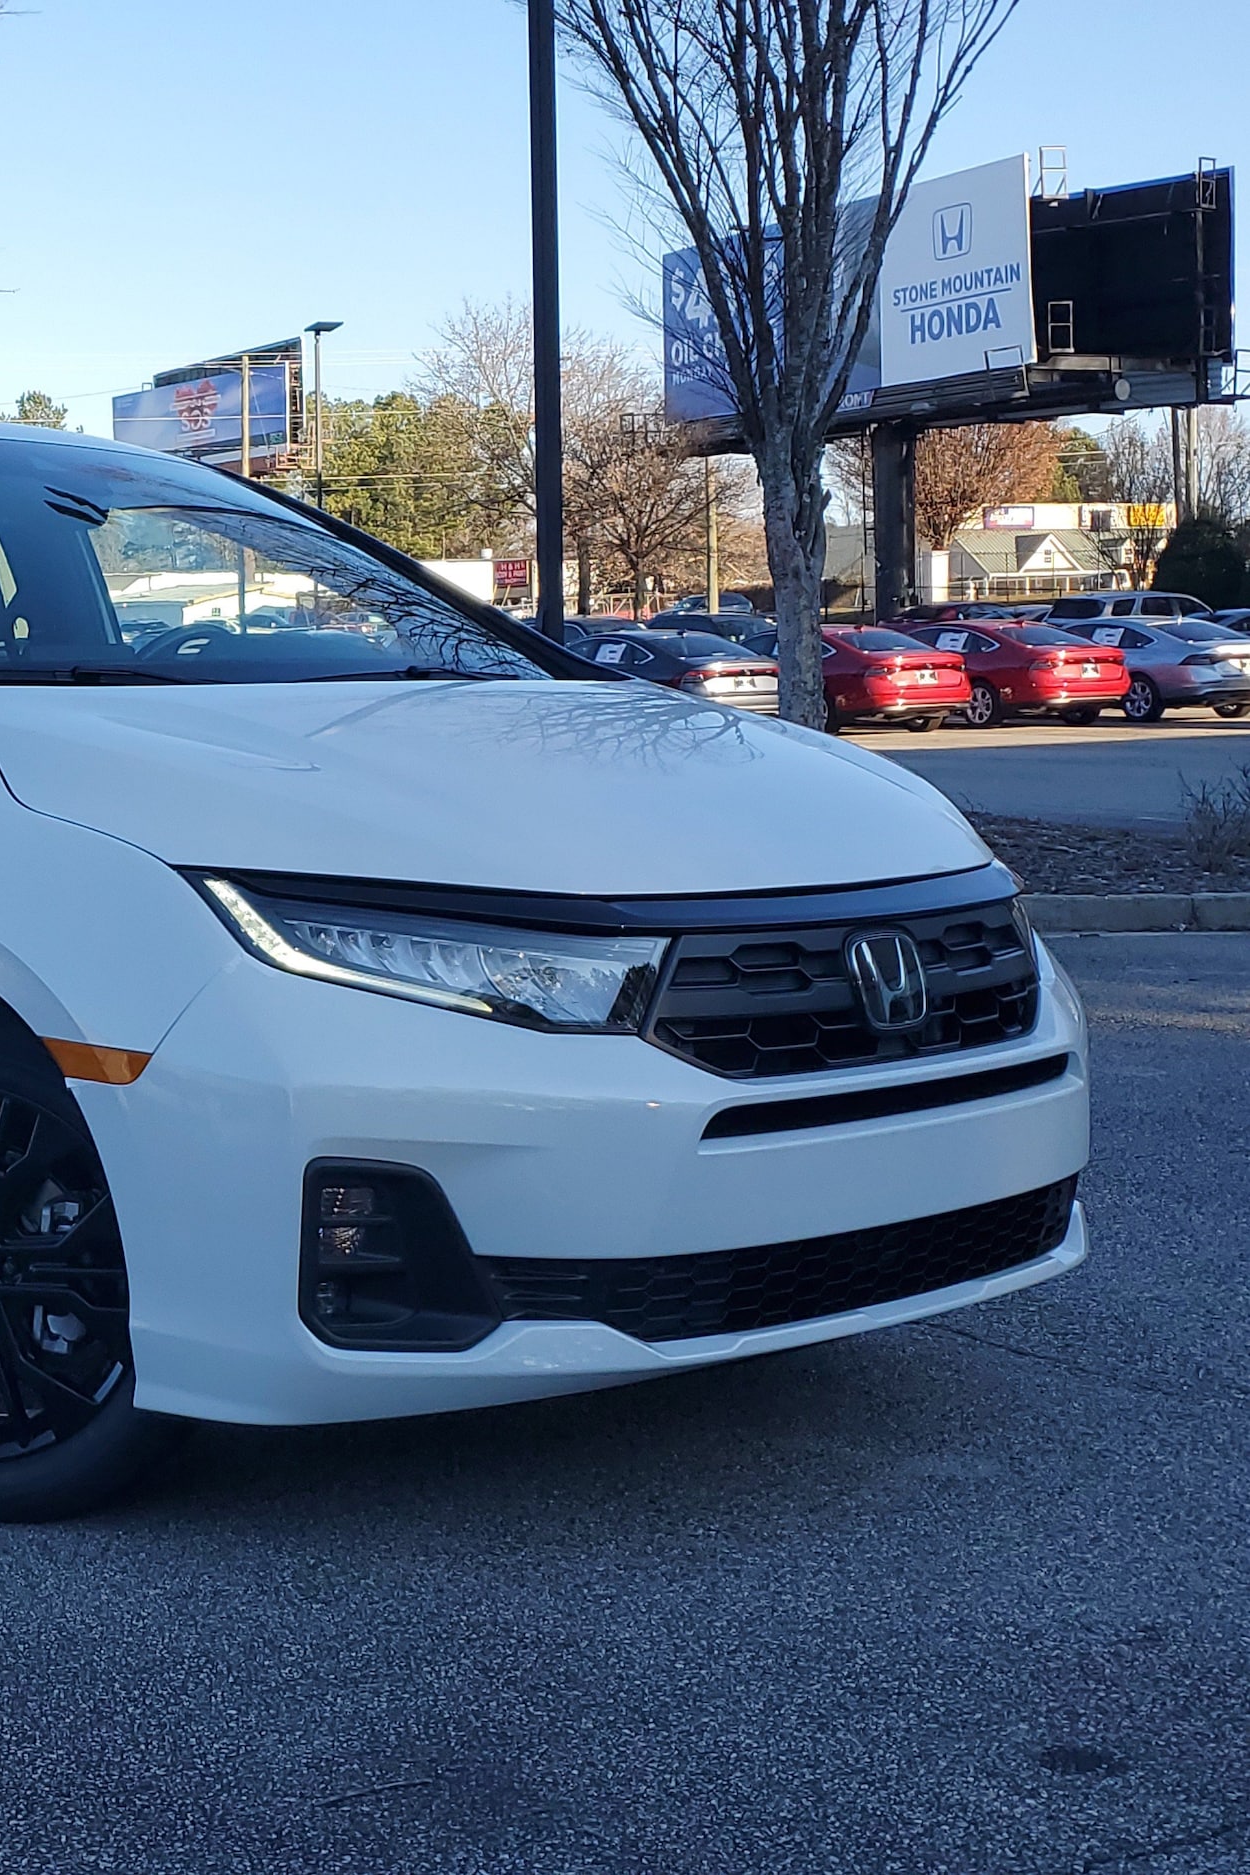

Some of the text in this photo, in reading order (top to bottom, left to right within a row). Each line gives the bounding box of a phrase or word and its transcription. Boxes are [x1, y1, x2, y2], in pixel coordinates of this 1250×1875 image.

[893, 262, 1021, 306] STONE MOUNTAIN
[910, 297, 1001, 344] HONDA
